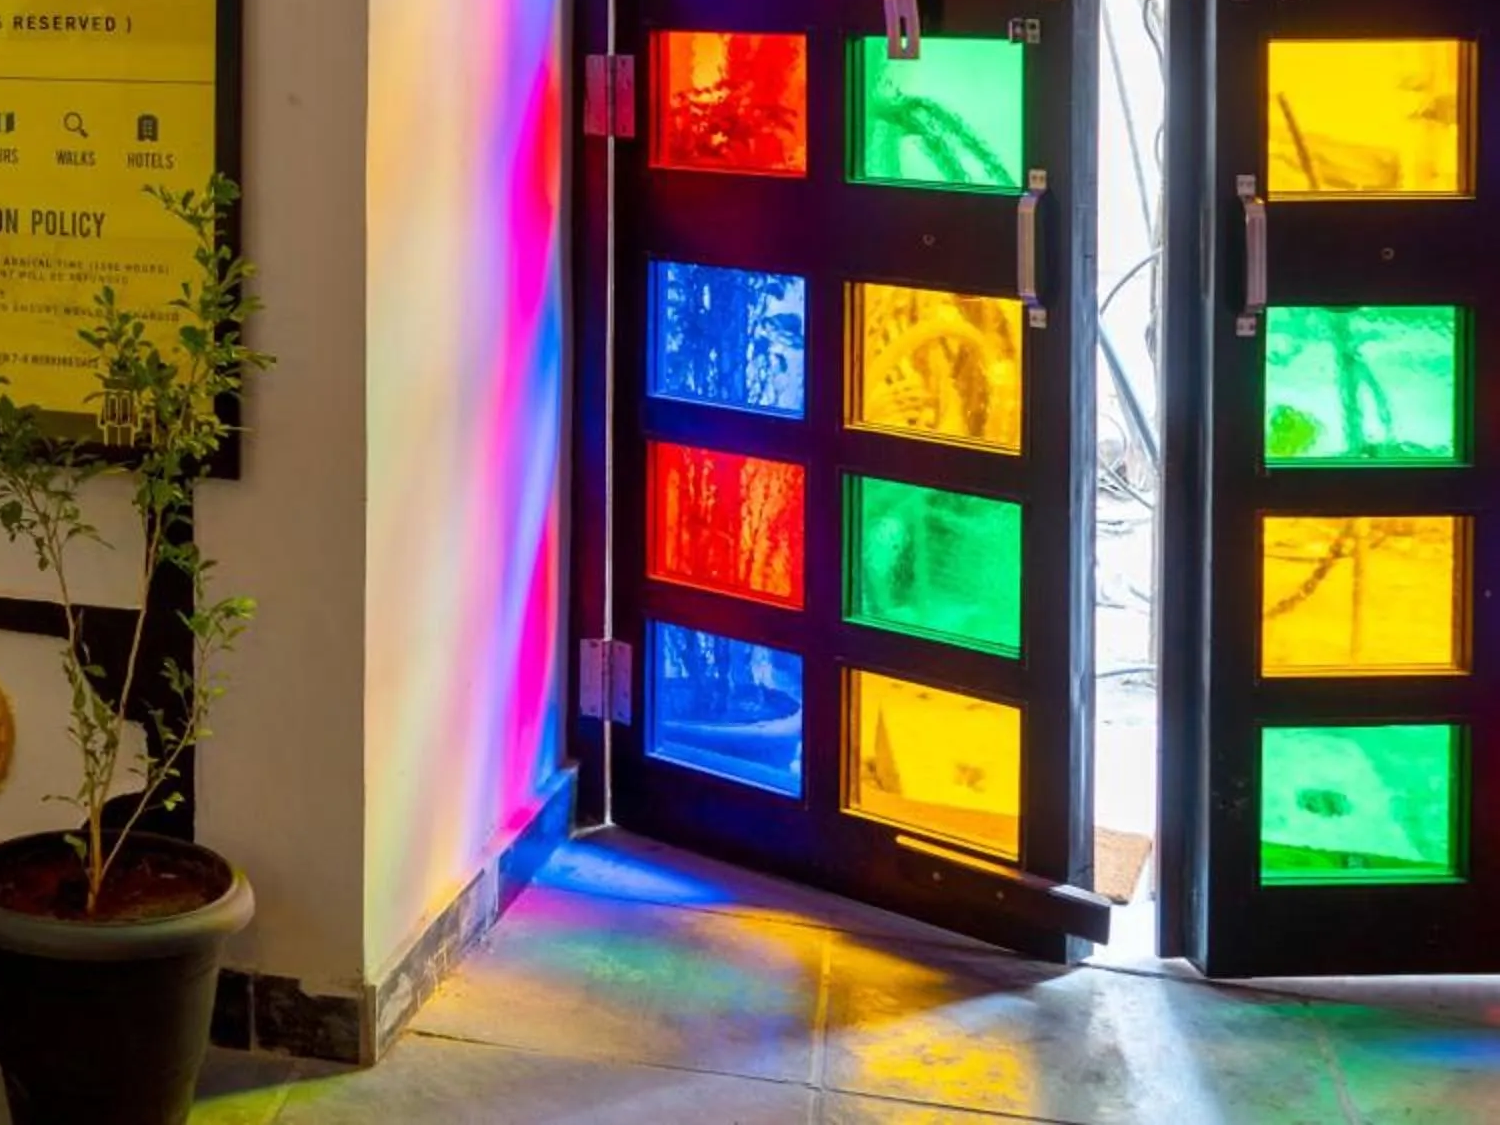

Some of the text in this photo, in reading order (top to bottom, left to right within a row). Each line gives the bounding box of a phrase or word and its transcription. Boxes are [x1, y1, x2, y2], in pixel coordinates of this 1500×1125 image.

[13, 15, 116, 32] RESERVED
[55, 149, 96, 167] WALKS
[127, 152, 174, 170] HOTELS
[31, 209, 106, 239] POLICY
